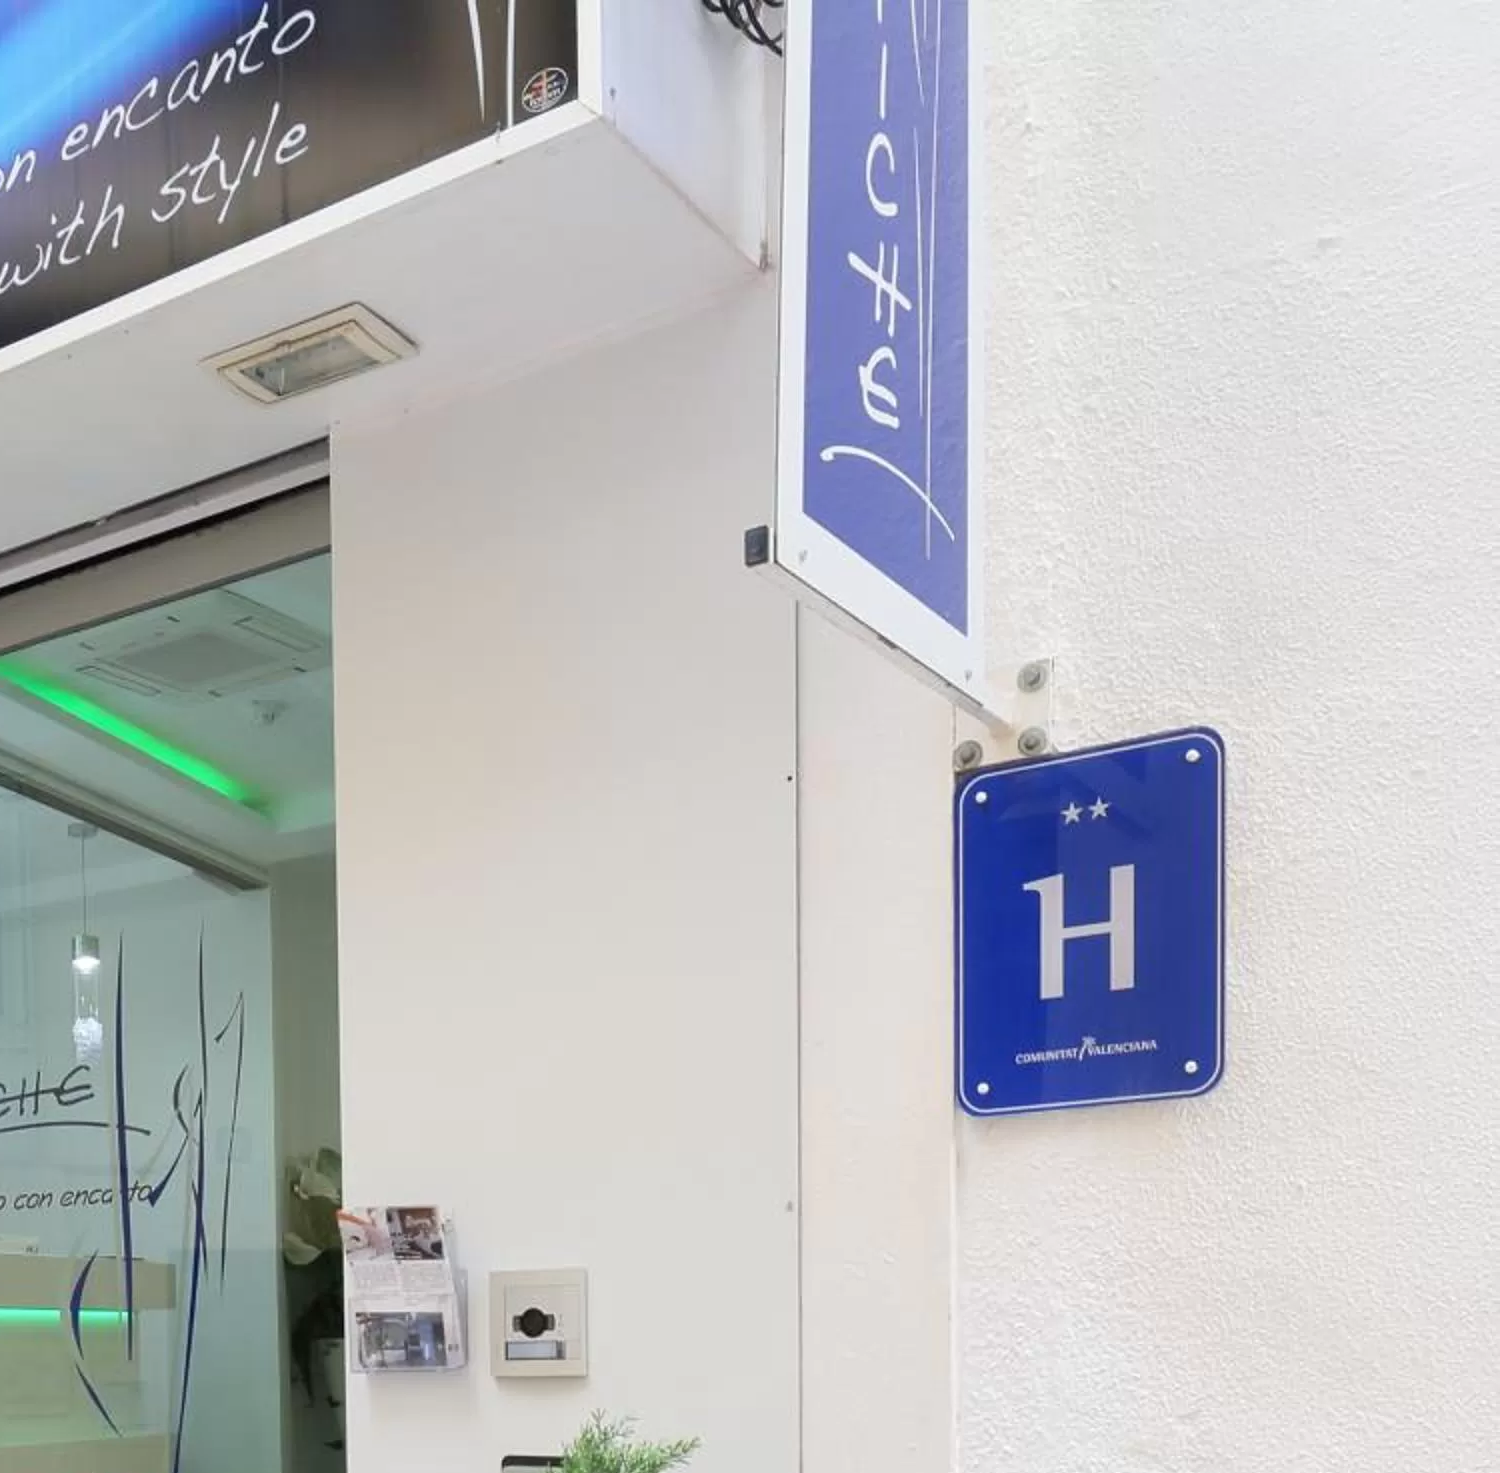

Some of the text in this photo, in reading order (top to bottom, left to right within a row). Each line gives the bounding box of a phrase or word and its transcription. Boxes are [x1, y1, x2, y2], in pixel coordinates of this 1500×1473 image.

[60, 3, 316, 162] encanto
[152, 103, 309, 224] style
[1023, 863, 1136, 1001] H
[1015, 1039, 1158, 1065] COMUNITAT VALENCIANA
[14, 1189, 54, 1210] con
[60, 1179, 154, 1207] encato
